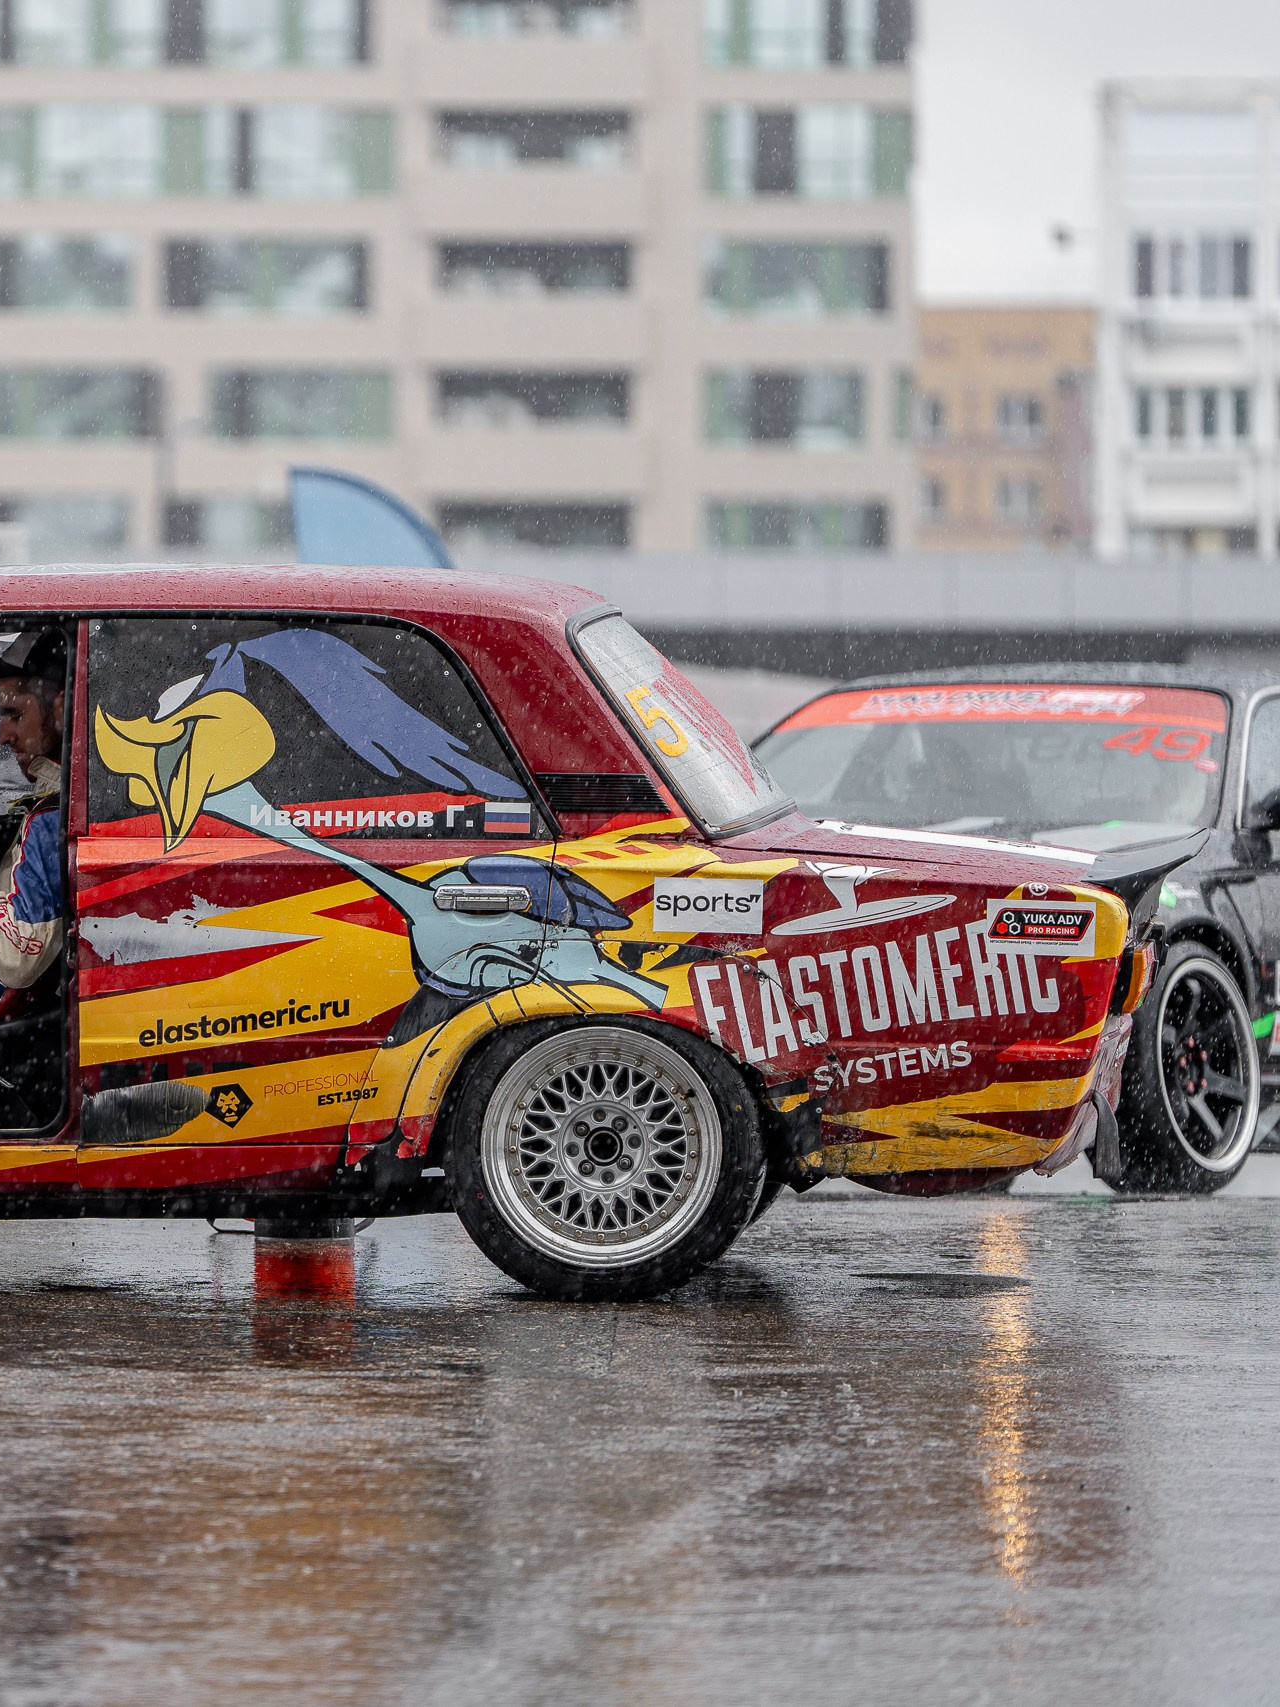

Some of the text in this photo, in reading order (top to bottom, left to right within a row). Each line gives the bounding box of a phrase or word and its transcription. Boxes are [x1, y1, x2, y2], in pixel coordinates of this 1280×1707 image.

[625, 685, 689, 757] 5
[1102, 726, 1213, 761] 49
[249, 804, 474, 828] Иванников Г.
[1022, 913, 1083, 926] YUKA ADV
[1027, 927, 1076, 935] PRO RACING
[138, 997, 351, 1048] elastomeric.ru
[814, 1040, 973, 1092] SYSTEMS
[263, 1068, 380, 1099] PROFESSIONAL
[317, 1086, 380, 1107] EST.1987
